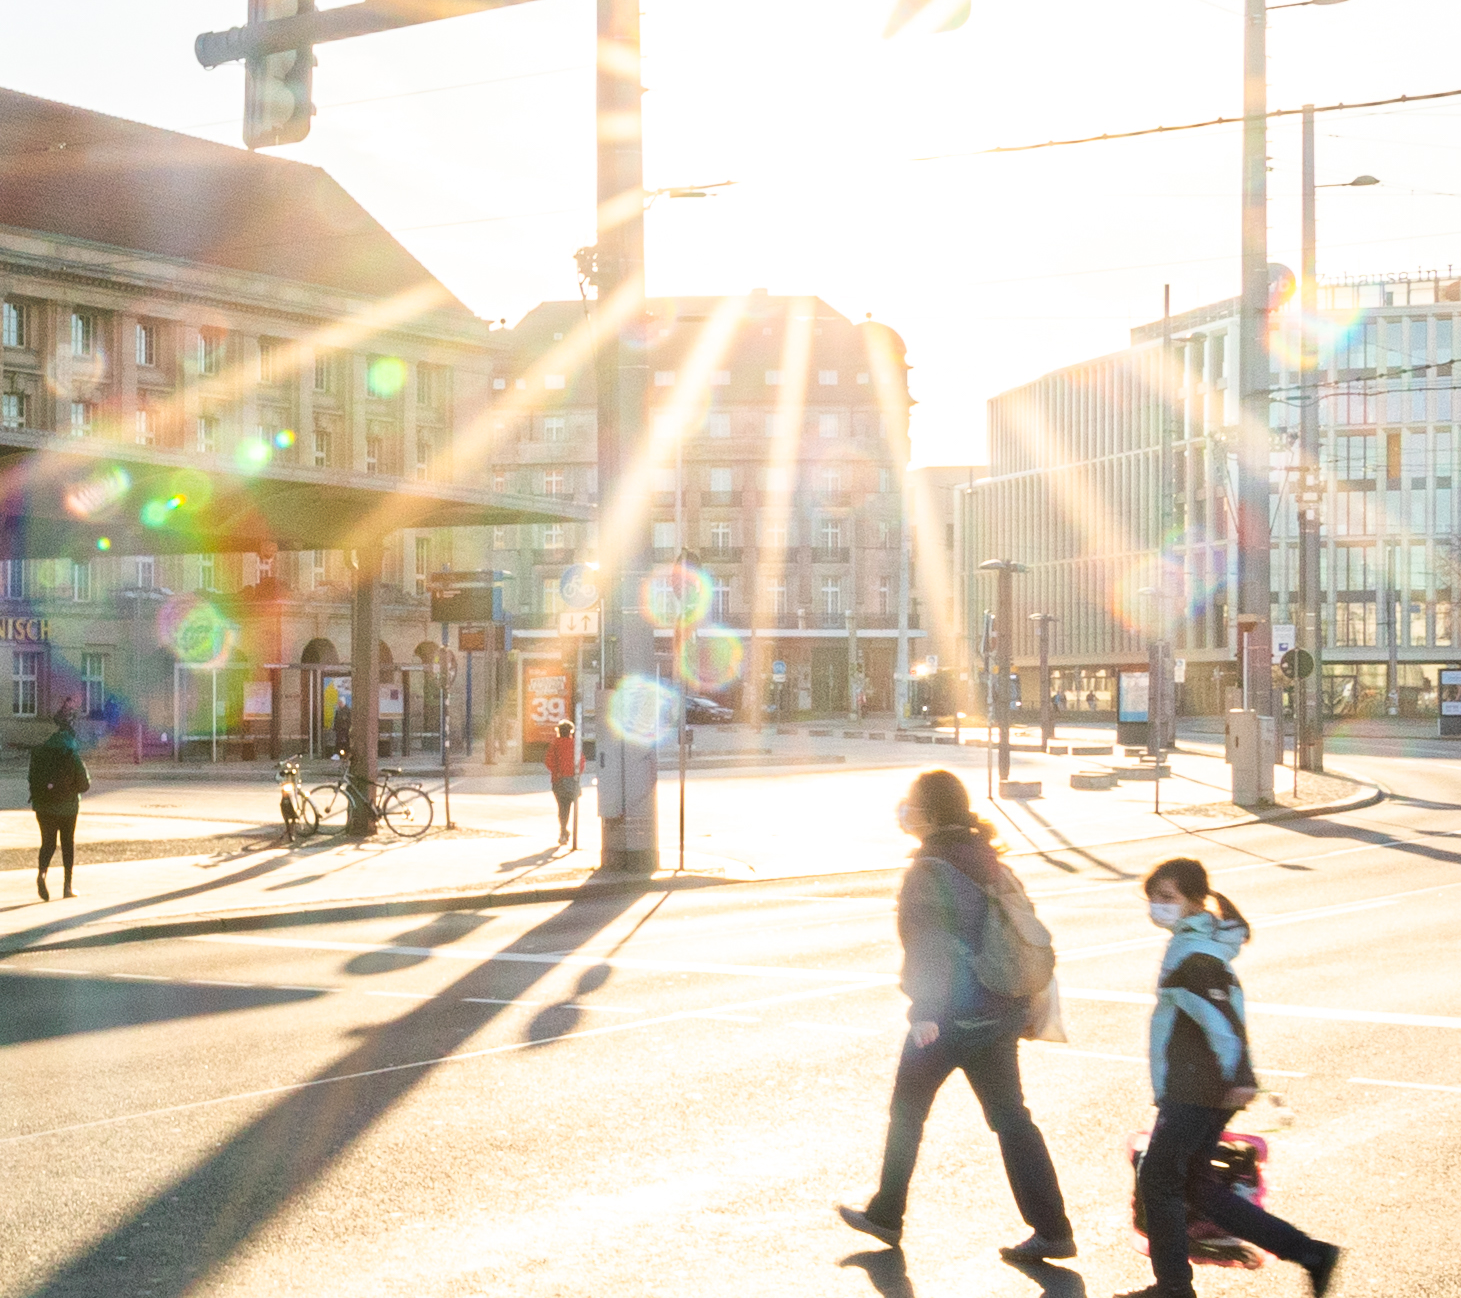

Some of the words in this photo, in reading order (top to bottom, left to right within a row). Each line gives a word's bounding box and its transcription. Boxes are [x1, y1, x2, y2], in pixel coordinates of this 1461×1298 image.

[1316, 270, 1409, 287] Zuhause
[1418, 265, 1438, 281] in
[531, 697, 566, 723] 39
